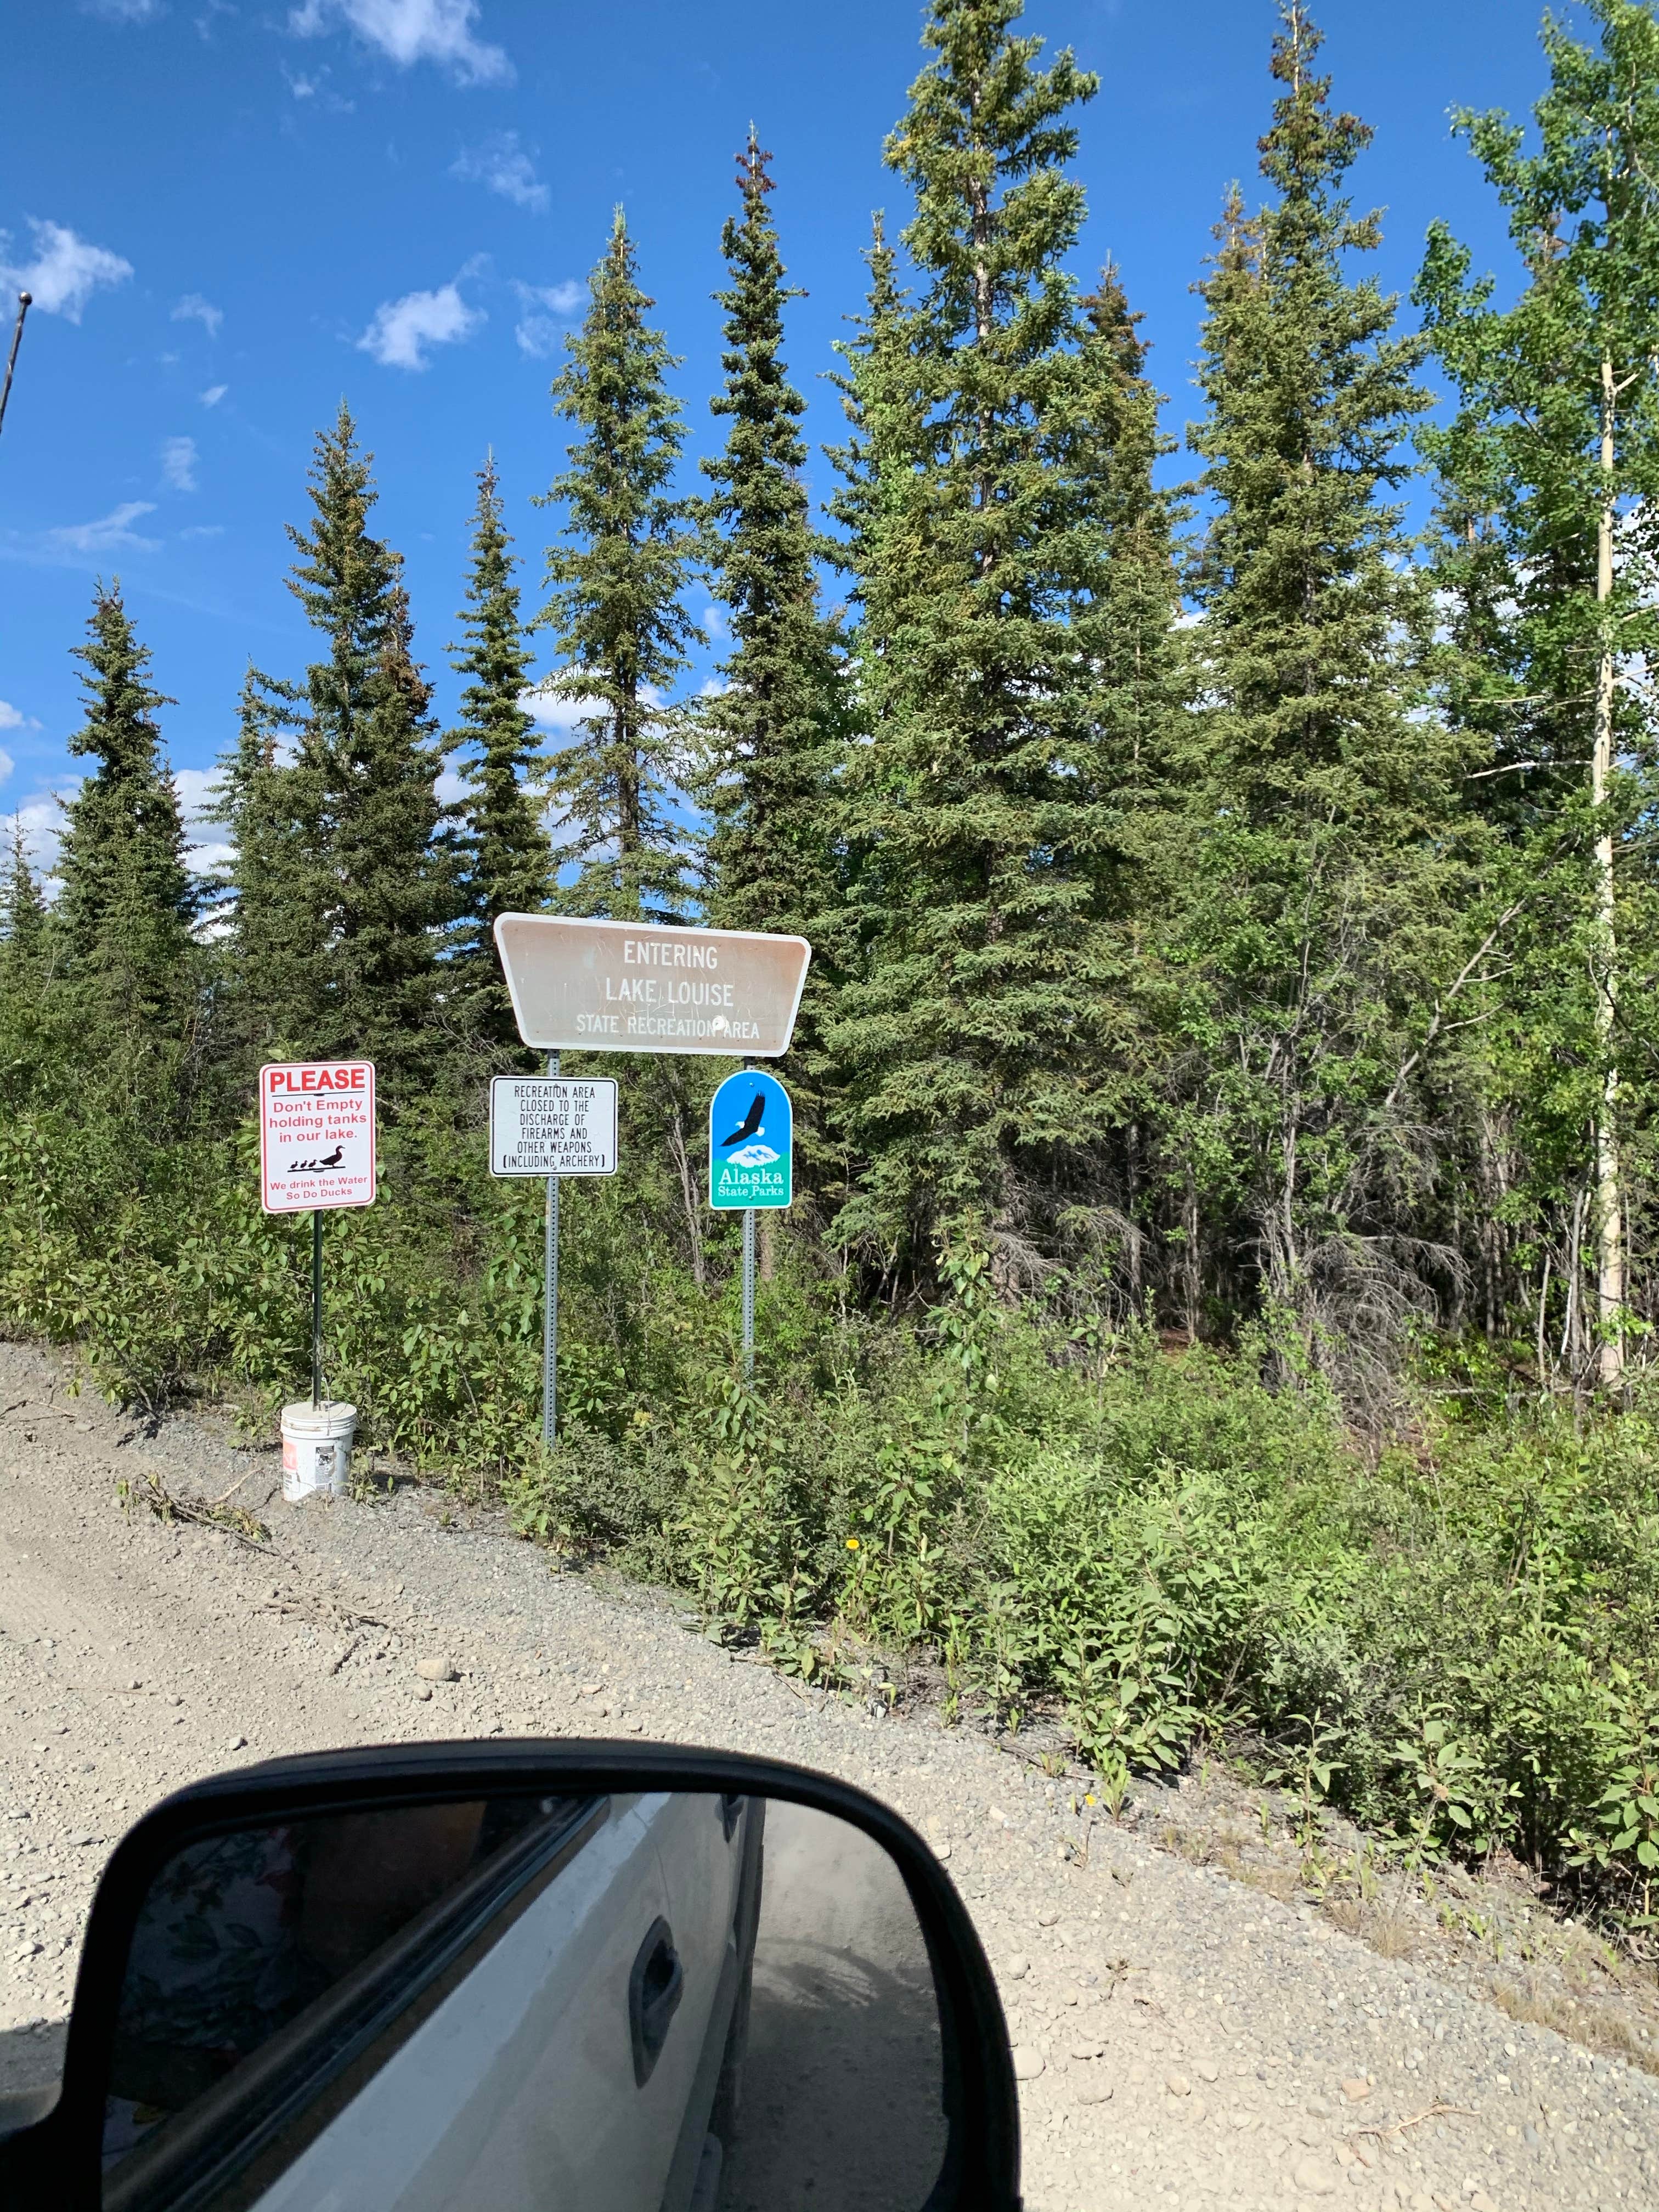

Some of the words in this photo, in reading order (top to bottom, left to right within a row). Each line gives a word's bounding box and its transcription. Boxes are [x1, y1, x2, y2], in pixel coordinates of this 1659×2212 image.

[624, 940, 718, 969] ENTERING
[606, 978, 657, 1002] LAKE
[668, 981, 733, 1007] LOUISE
[577, 1014, 619, 1033] STATE
[724, 1022, 760, 1039] AREA
[270, 1069, 365, 1092] PLEASE
[515, 1086, 567, 1098] RECREATION
[573, 1087, 595, 1098] AREA
[274, 1101, 312, 1113] Don't
[317, 1099, 363, 1111] Empty
[521, 1100, 554, 1111] CLOSED
[560, 1101, 569, 1111] TO
[574, 1101, 589, 1112] THE
[269, 1116, 323, 1128] holding
[328, 1114, 366, 1124] tanks
[520, 1114, 569, 1125] DISCHARGE
[575, 1114, 585, 1125] OF
[279, 1132, 291, 1142] in
[297, 1132, 320, 1142] our
[325, 1128, 357, 1139] lake.
[522, 1128, 565, 1139] FIREARMS
[571, 1128, 587, 1139] AND
[517, 1142, 544, 1153] OTHER
[550, 1142, 591, 1153] WEAPONS
[290, 1180, 315, 1189] drink
[319, 1178, 335, 1187] the
[338, 1176, 368, 1186] Water
[718, 1168, 784, 1185] Alaska
[286, 1192, 300, 1200] So
[303, 1190, 317, 1199] Do
[321, 1188, 352, 1197] Ducks
[718, 1186, 748, 1197] State
[752, 1186, 784, 1196] Parks
